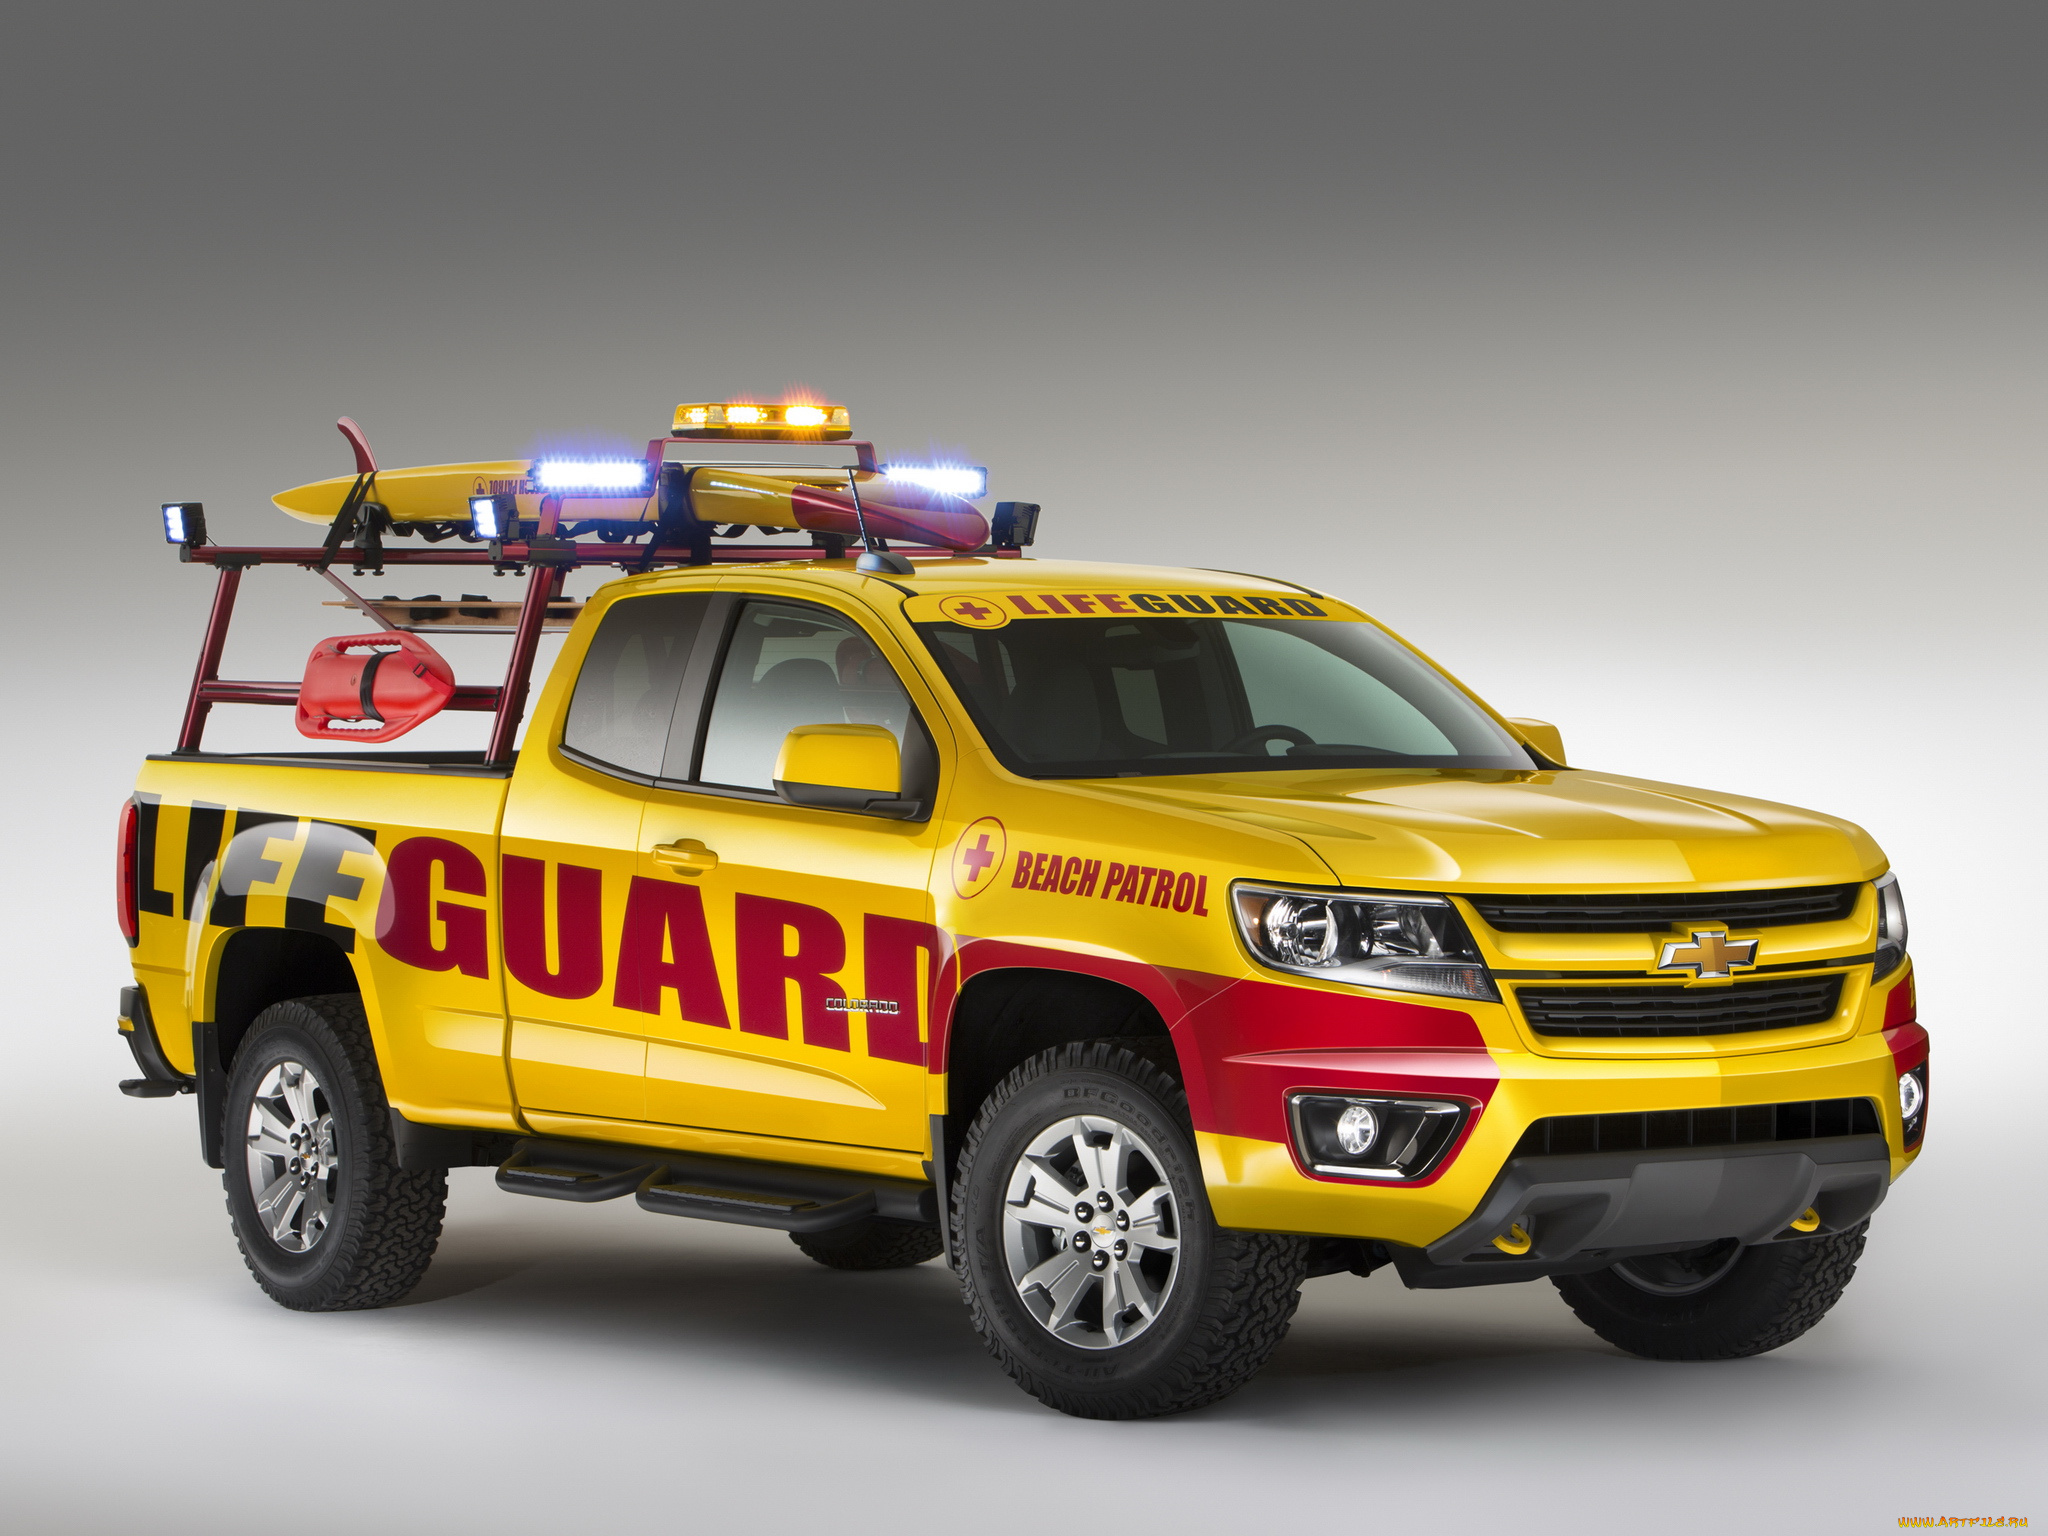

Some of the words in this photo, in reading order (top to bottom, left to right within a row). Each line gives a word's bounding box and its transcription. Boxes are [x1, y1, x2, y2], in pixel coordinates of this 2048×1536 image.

[1006, 594, 1328, 617] LIFEGUARD
[1011, 850, 1102, 897] BEACH
[1100, 861, 1209, 917] PATROL
[134, 790, 957, 1075] LIFEGUARD
[826, 997, 900, 1015] COLORADO
